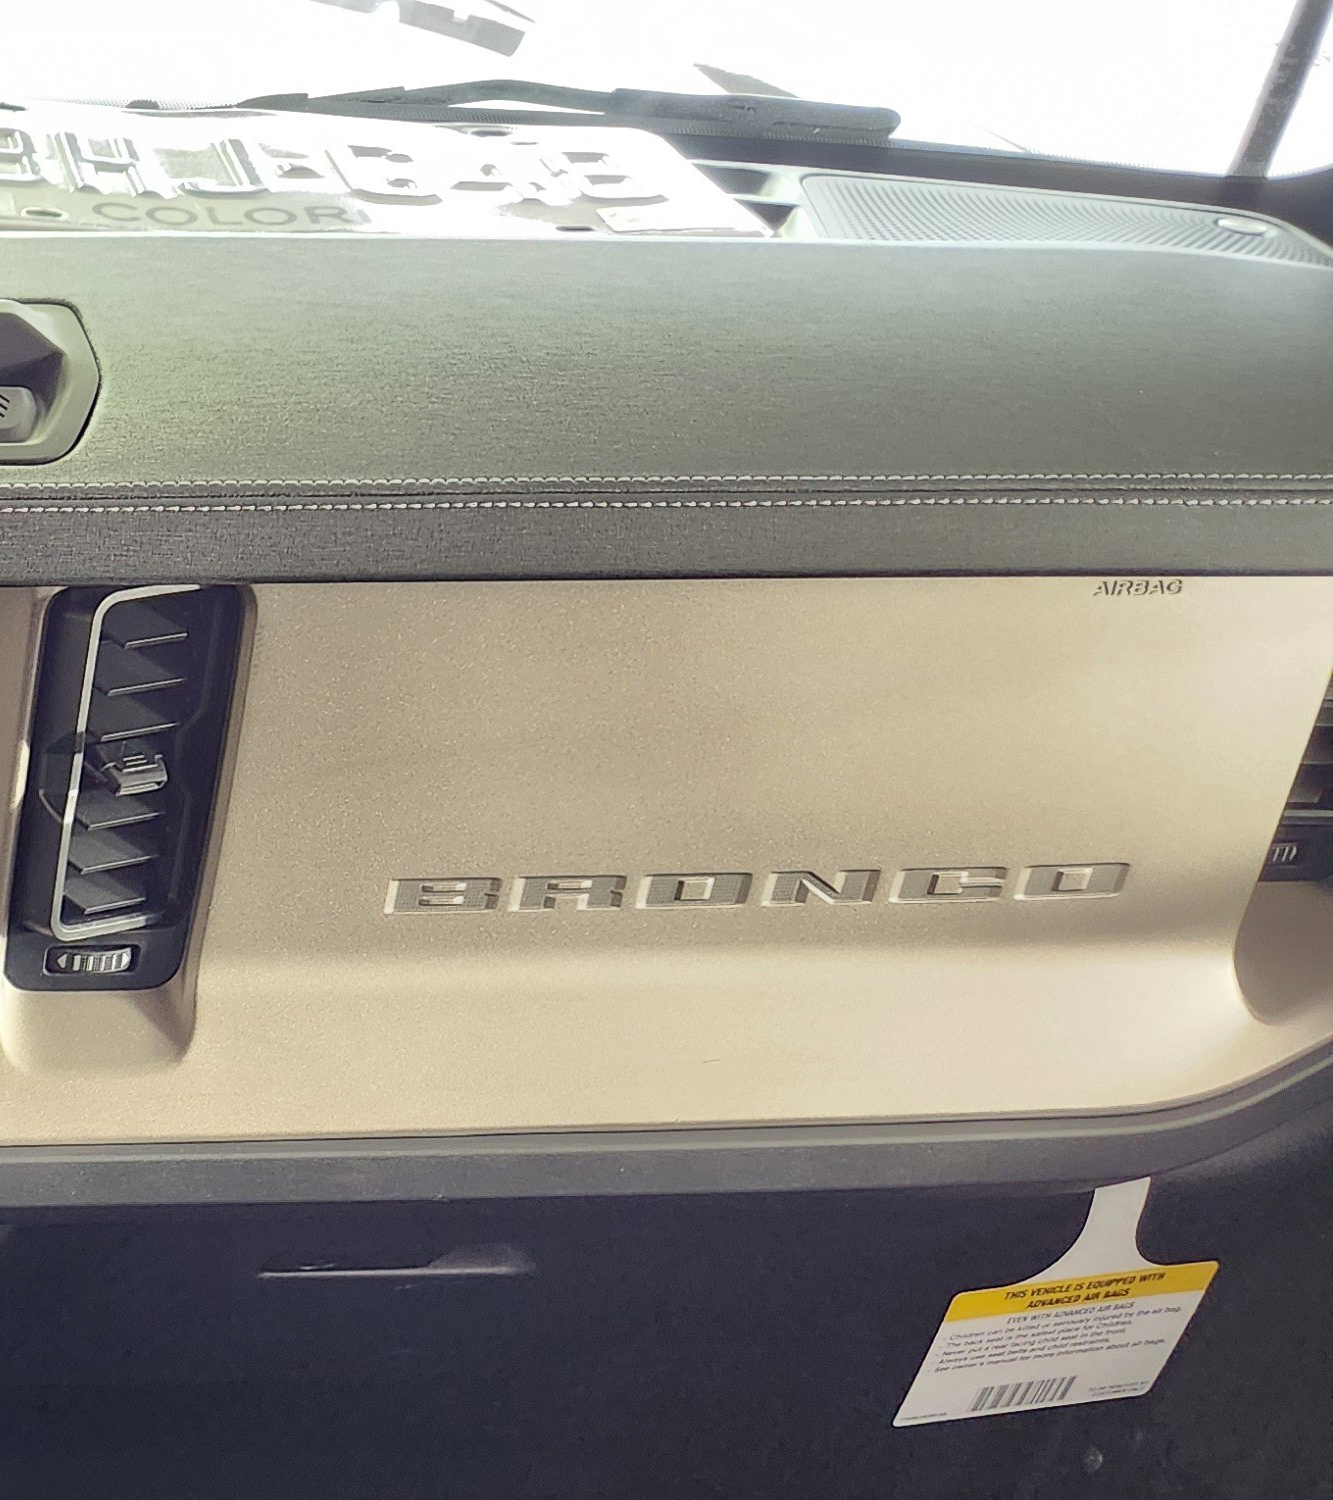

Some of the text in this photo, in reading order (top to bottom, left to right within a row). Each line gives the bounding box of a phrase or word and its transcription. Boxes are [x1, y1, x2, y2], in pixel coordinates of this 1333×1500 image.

[1094, 579, 1183, 596] AIRBAG
[384, 862, 1131, 914] BRONCO
[1003, 1290, 1028, 1299] THIS
[1028, 1285, 1073, 1296] VEHICLE
[1086, 1276, 1137, 1288] EQUIPPED
[1137, 1273, 1166, 1282] WITH
[1025, 1288, 1131, 1308] ADVANCED AIR BAGS
